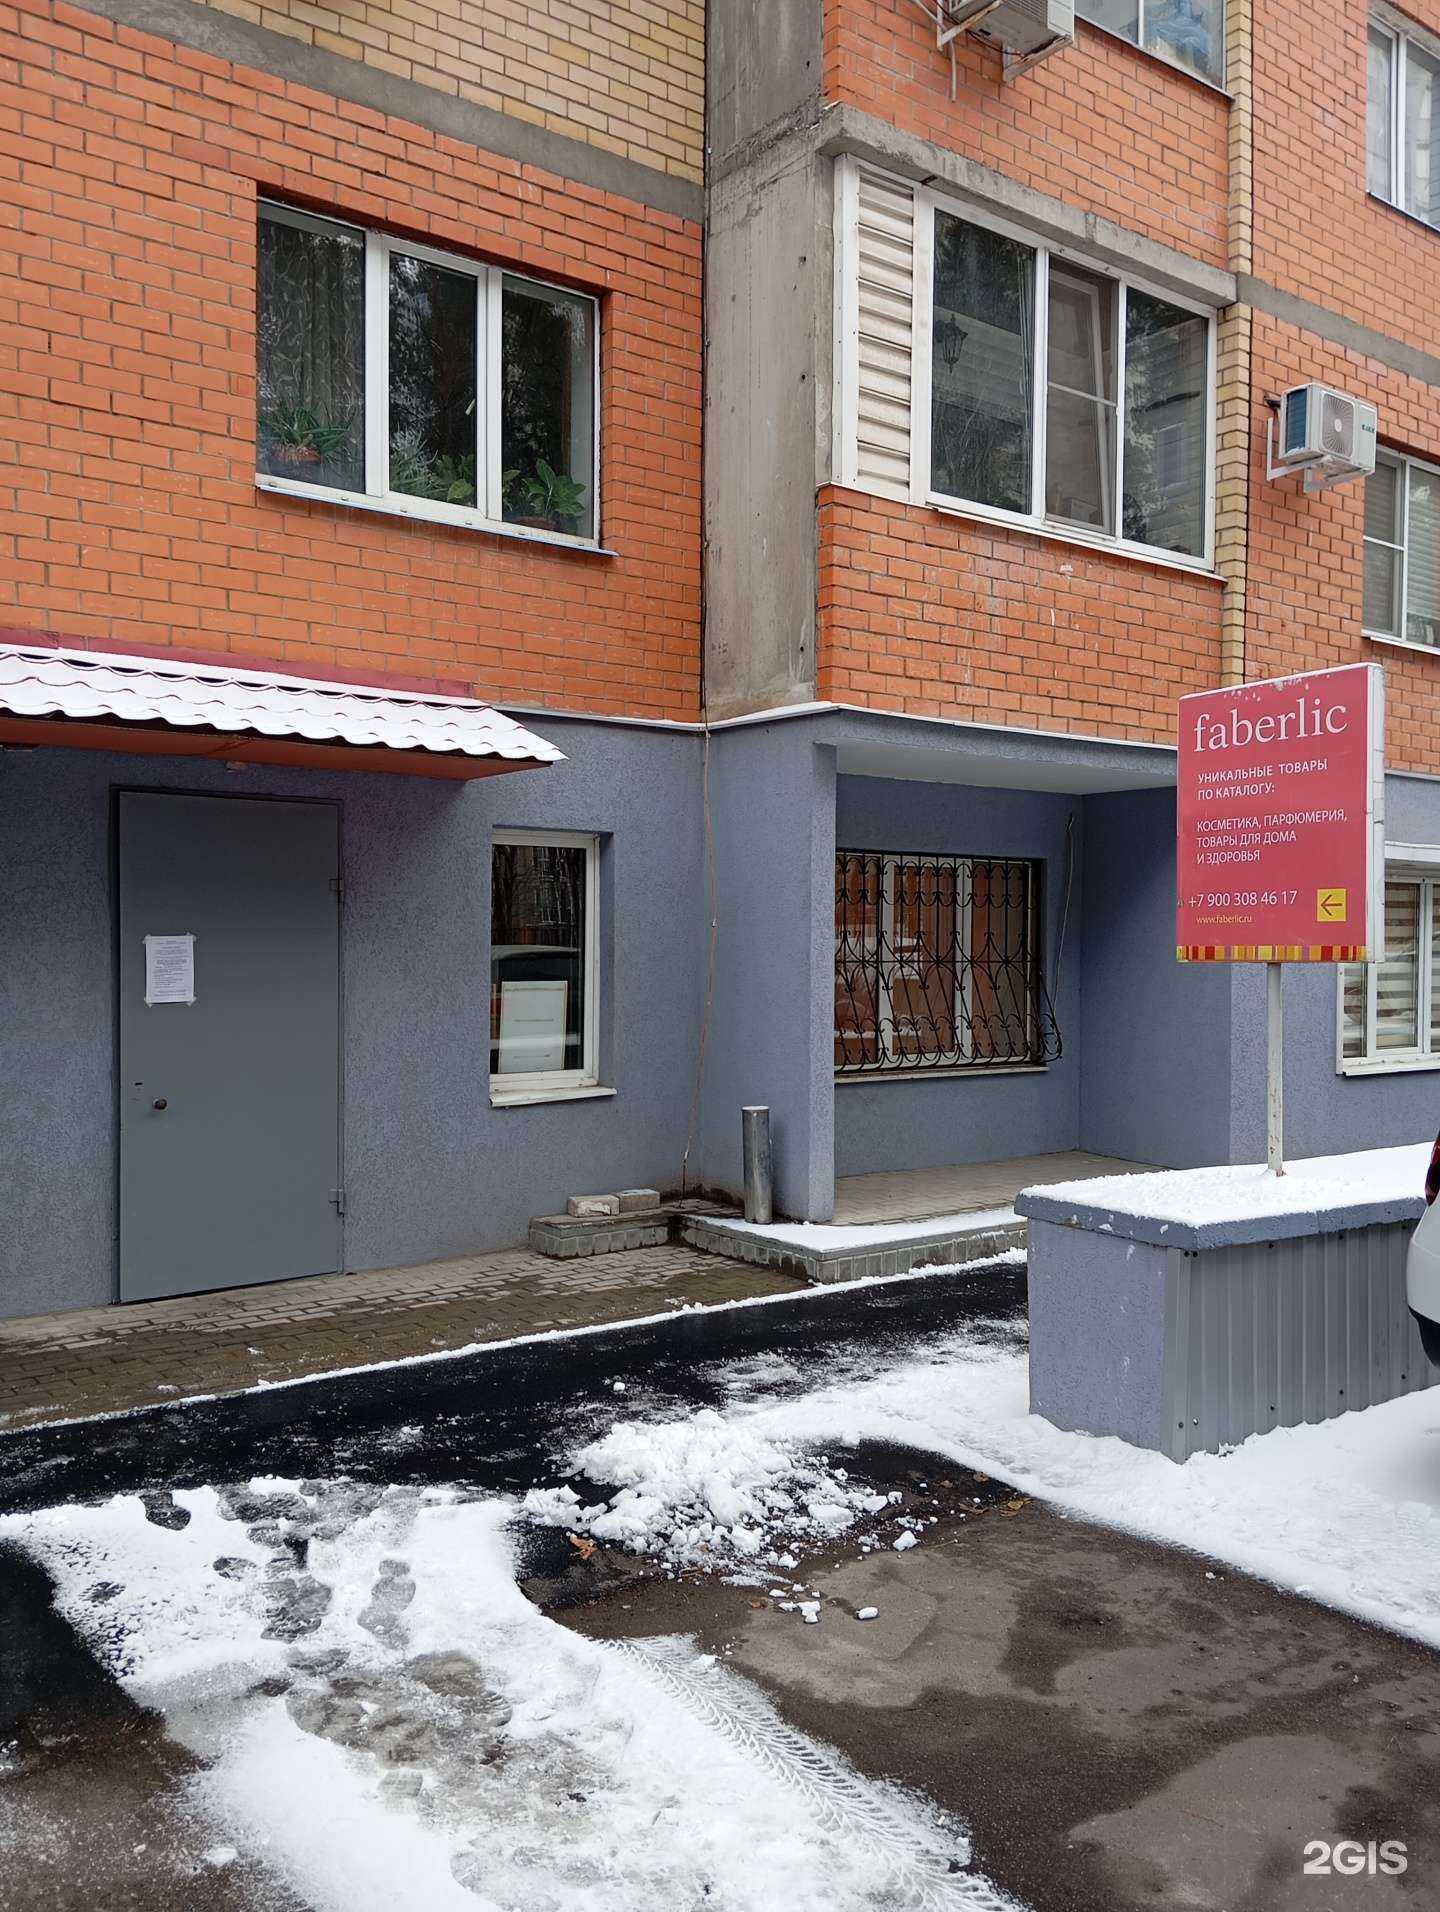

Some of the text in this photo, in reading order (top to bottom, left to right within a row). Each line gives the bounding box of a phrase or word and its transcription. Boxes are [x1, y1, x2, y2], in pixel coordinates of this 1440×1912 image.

[1193, 698, 1348, 752] faberlic
[1198, 759, 1328, 784] УНИКАЛЬНЫЕ ТОВАРЫ
[1198, 782, 1275, 800] ПО КАТАЛОГУ:
[1197, 809, 1347, 832] КОСМЕТИКА, ПАРФЮМЕРИЯ,
[1197, 831, 1297, 848] ТОВАРЫ ДЛЯ ДОМА
[1197, 850, 1260, 865] И ЗДОРОВЬЯ
[1188, 890, 1298, 907] +7 900 308 46 17
[1196, 914, 1253, 925] www.faberlic.ru
